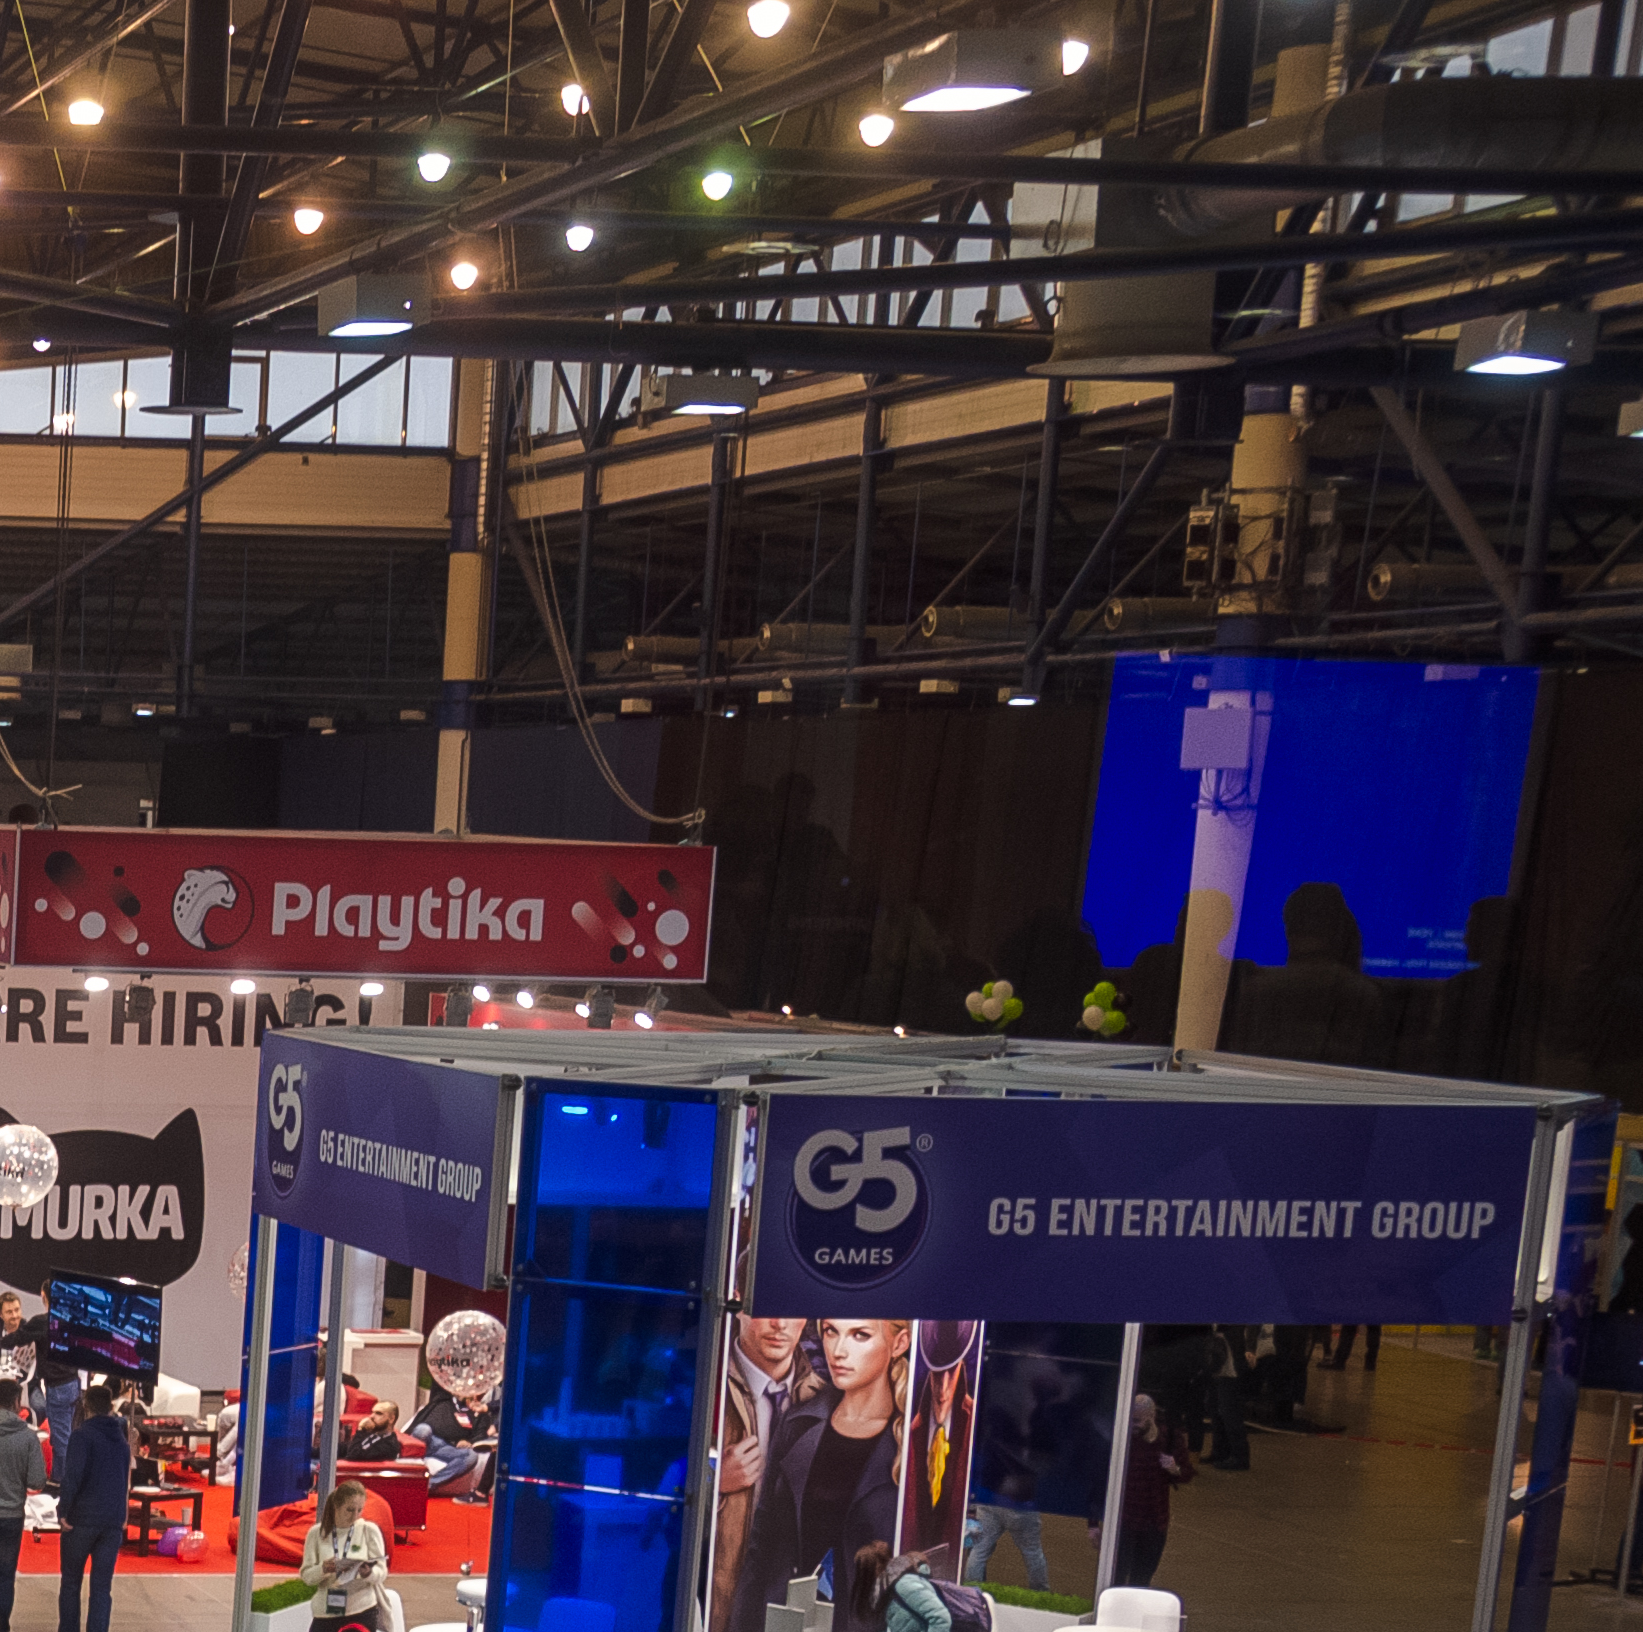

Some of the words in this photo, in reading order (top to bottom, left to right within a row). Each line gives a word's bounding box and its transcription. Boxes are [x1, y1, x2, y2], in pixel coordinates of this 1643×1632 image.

[271, 877, 543, 950] Playtika
[269, 1063, 303, 1152] G5
[272, 1160, 294, 1180] GAMES
[319, 1129, 335, 1164] G5
[336, 1133, 436, 1191] ENTERTAINMENT
[437, 1158, 482, 1203] GROUP
[794, 1125, 918, 1234] G5
[1, 1184, 185, 1241] MURKA
[987, 1198, 1035, 1236] G5
[1048, 1199, 1362, 1238] ENTERTAINMENT
[1370, 1201, 1495, 1239] GROUP
[814, 1247, 894, 1265] GAMES
